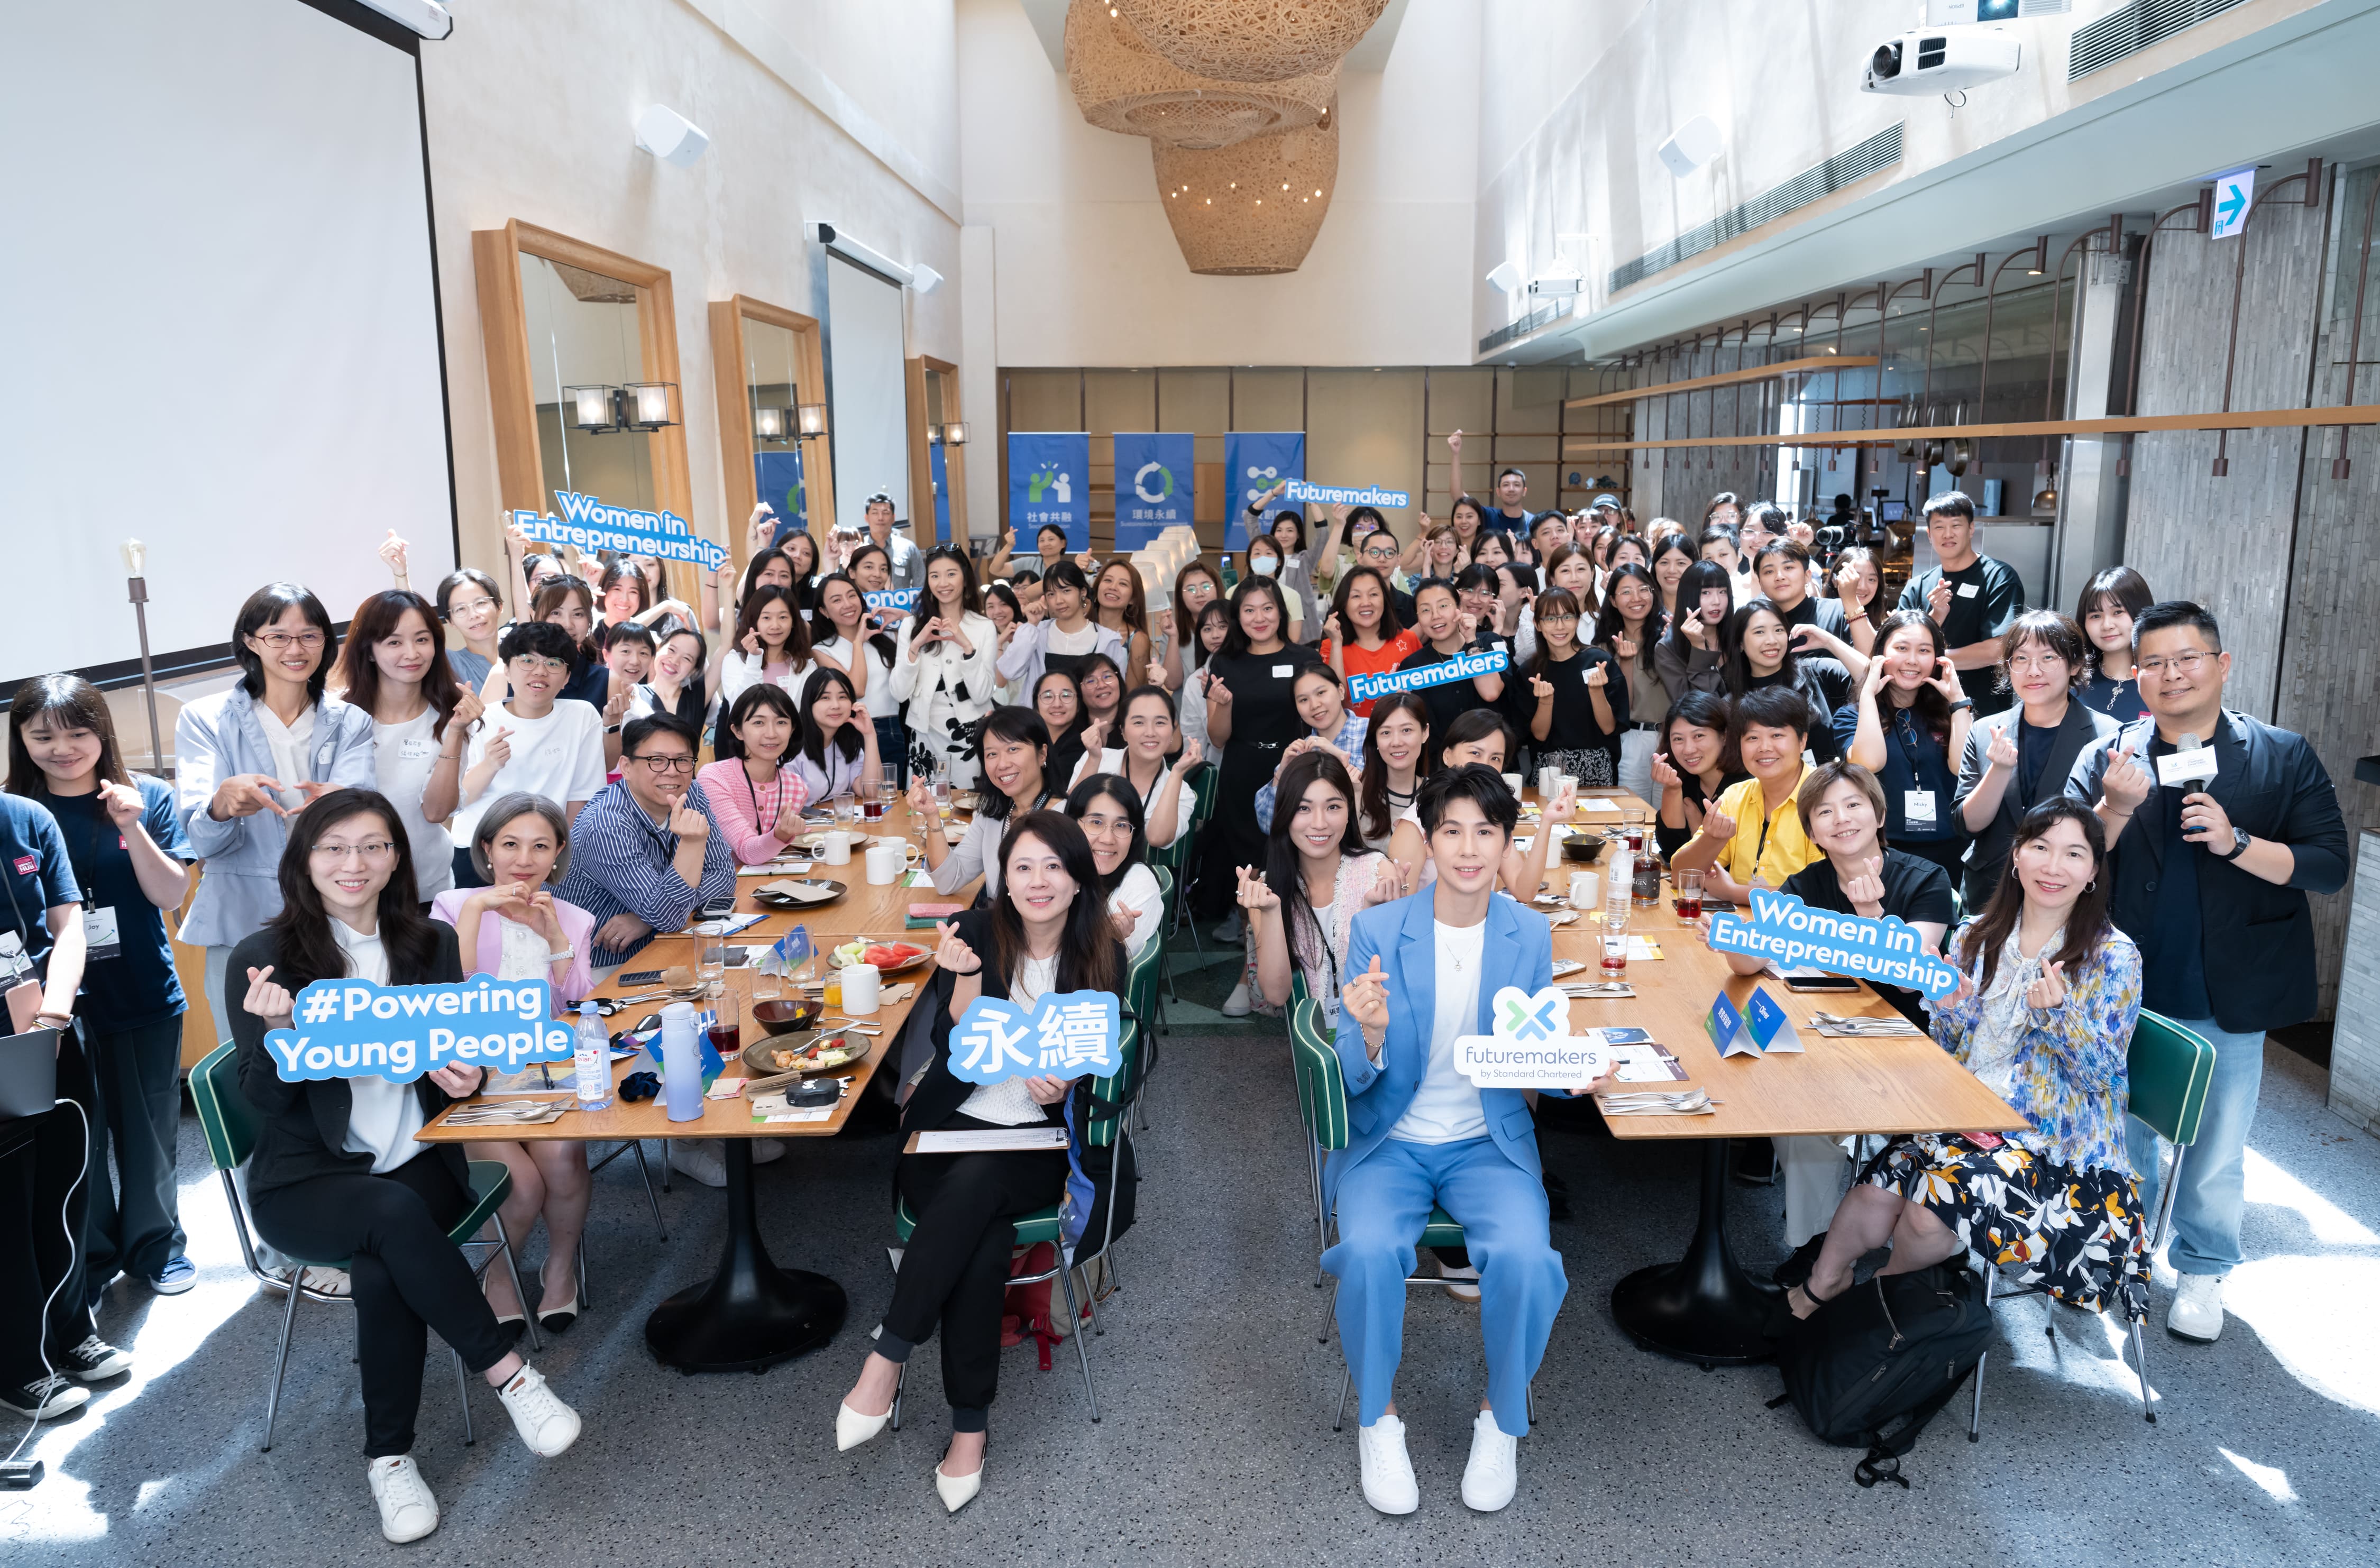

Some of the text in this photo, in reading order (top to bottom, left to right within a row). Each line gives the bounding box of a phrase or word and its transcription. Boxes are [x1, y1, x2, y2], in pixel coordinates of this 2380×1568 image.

[561, 493, 685, 536] Women in
[1287, 482, 1407, 506] Futuremakers
[1027, 512, 1072, 522] 社會共融
[518, 515, 725, 570] Entrepreneurship
[1351, 654, 1505, 699] Futuremakers
[1757, 896, 1915, 953] Women in
[1715, 921, 1953, 994] Entrepreneurship
[303, 981, 541, 1023] #Powering
[274, 1022, 568, 1074] Young People
[960, 1002, 1111, 1074] 永續
[1466, 1046, 1597, 1064] futuremakers
[1481, 1069, 1582, 1079] by Standard Chartered
